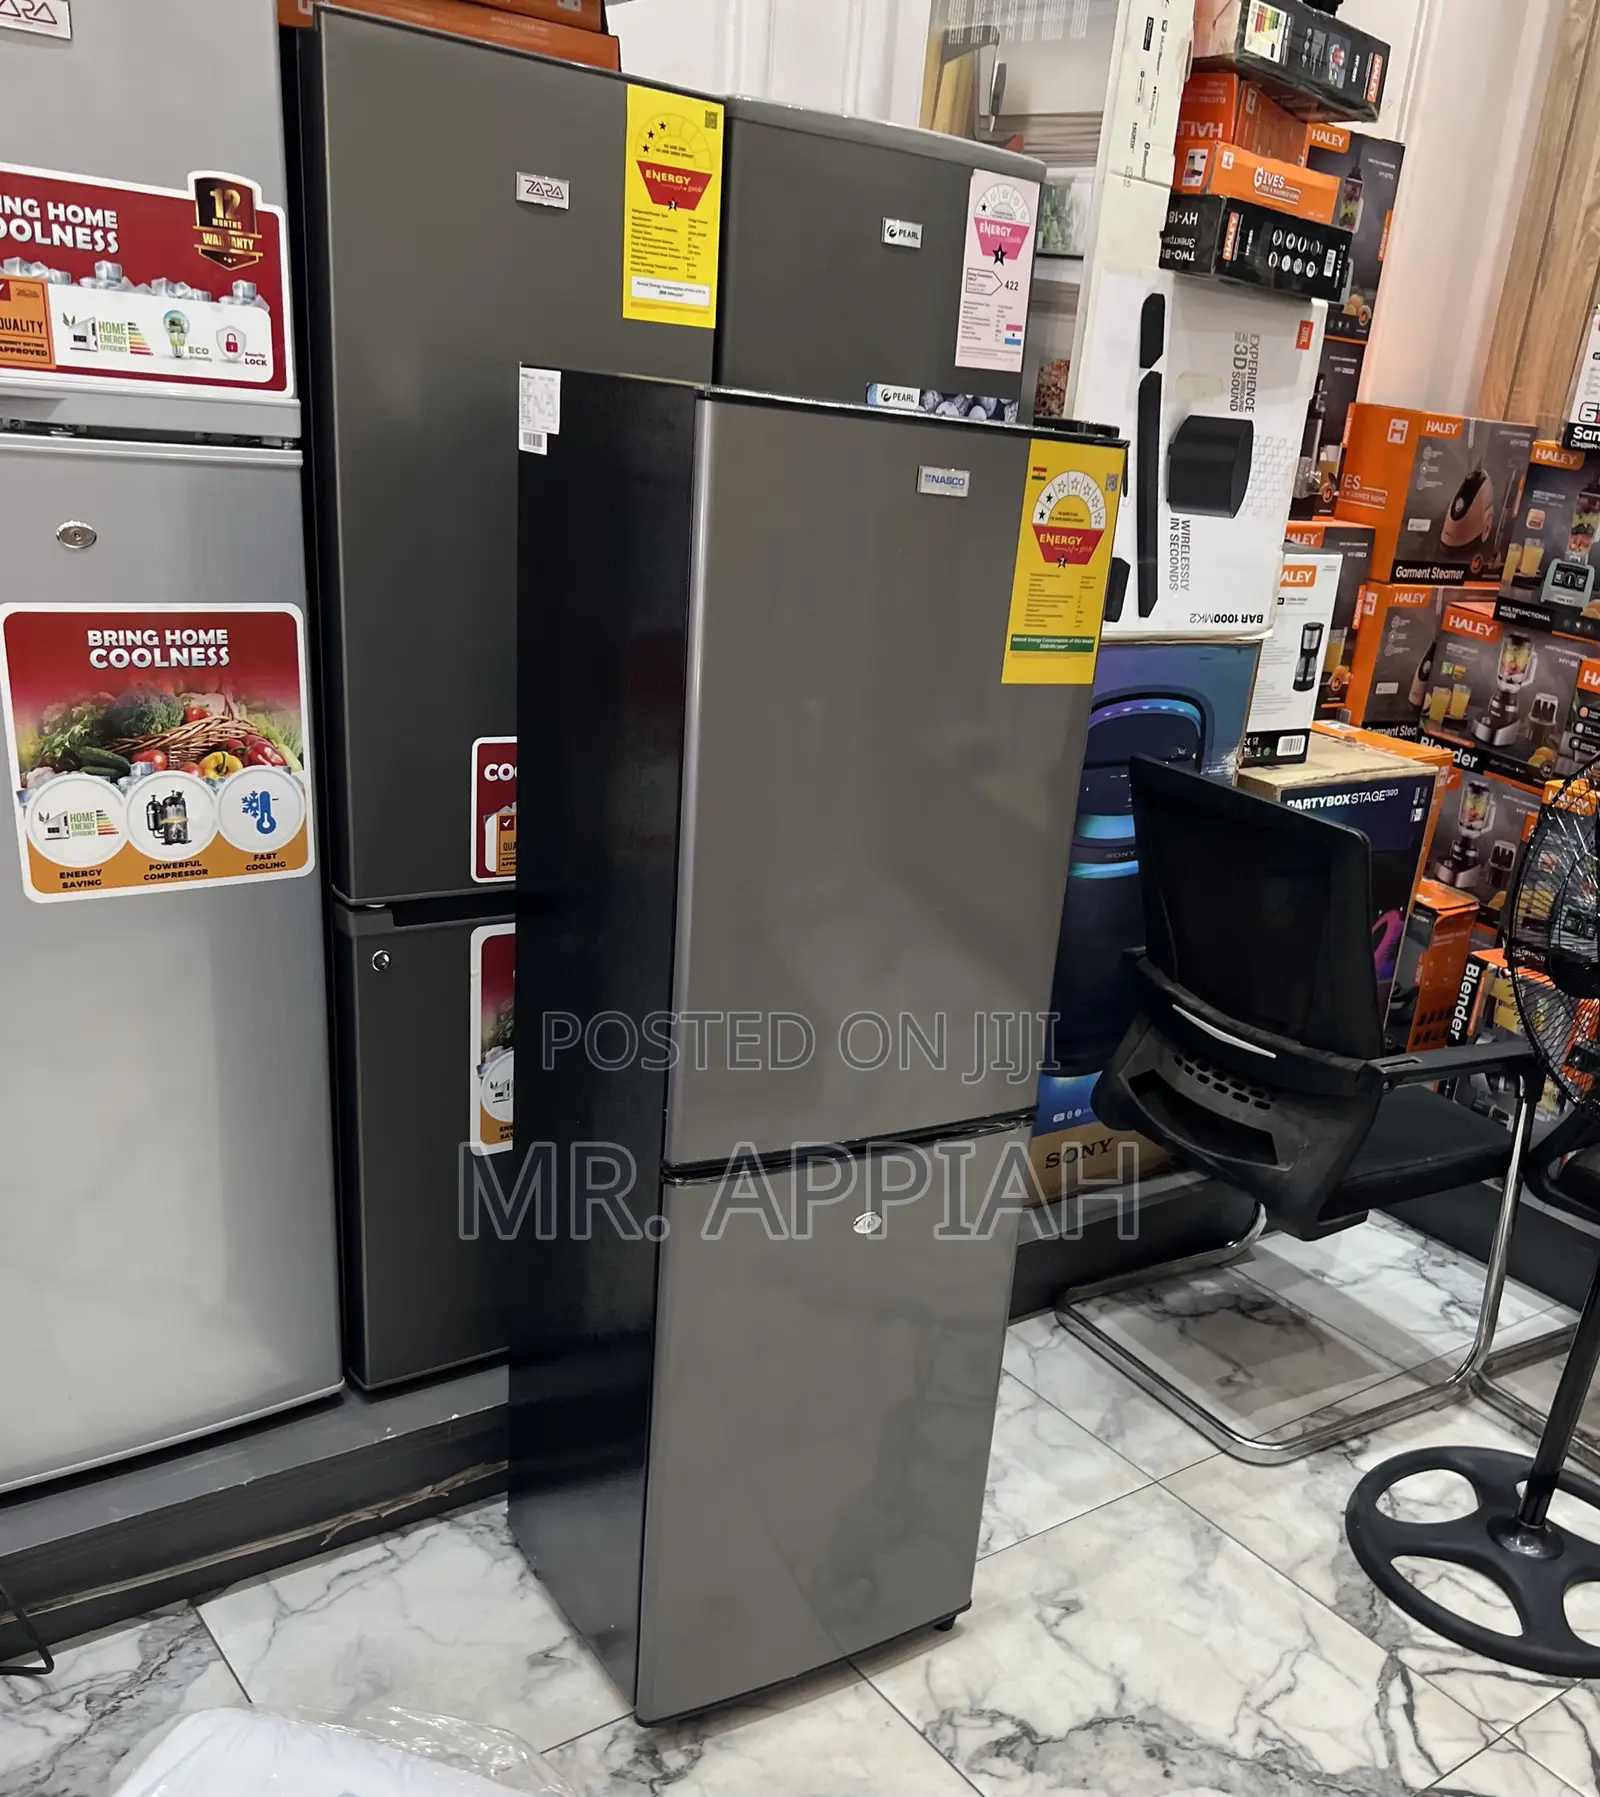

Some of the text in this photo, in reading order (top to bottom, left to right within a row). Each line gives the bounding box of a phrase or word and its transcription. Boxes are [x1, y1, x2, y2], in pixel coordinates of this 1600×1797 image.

[1368, 56, 1382, 98] HALEY
[1312, 129, 1345, 147] HALEY
[645, 168, 692, 186] ENERGY
[1254, 166, 1285, 188] GIVES
[523, 179, 565, 200] ZARA
[210, 188, 241, 219] 12
[47, 201, 118, 229] HOME
[212, 217, 242, 230] MONTHS
[979, 219, 1012, 238] ENERGY
[898, 228, 920, 240] PEARL
[1004, 280, 1019, 292] 422
[98, 320, 127, 334] HOME
[99, 334, 127, 345] ENERGY
[188, 346, 210, 356] ECO
[1233, 344, 1248, 370] 3D
[244, 358, 268, 367] LOCK
[1245, 333, 1260, 413] EXPERIENCE
[892, 391, 915, 402] PEARL
[1229, 370, 1240, 412] SOUND
[1426, 420, 1459, 435] HALEY
[1535, 449, 1577, 465] HALEY
[931, 474, 965, 487] NASCO
[1039, 532, 1083, 546] ENERGY
[1169, 517, 1180, 591] IN SECONDS
[1180, 519, 1191, 592] WIRELESSLY
[1395, 565, 1465, 580] Garment Steamer
[1394, 592, 1426, 604] HALEY
[1240, 613, 1264, 624] BAR
[1500, 605, 1551, 622] MULTIFUNCTIONAL
[1448, 615, 1494, 637] HALEY
[87, 628, 229, 648] BRING HOME
[89, 646, 230, 669] COOLNESS
[484, 763, 517, 781] CO
[69, 811, 96, 823] HOME
[70, 822, 97, 831] ENERGY
[253, 852, 278, 862] FAST
[1106, 850, 1136, 859] SONY
[148, 859, 203, 871] POWERFUL
[245, 861, 287, 872] COOLING
[59, 868, 103, 880] ENERGY
[143, 869, 209, 881] COMPRESSOR
[61, 878, 103, 890] SAVING
[1448, 963, 1481, 1041] Blender
[1044, 1136, 1115, 1170] SONY
